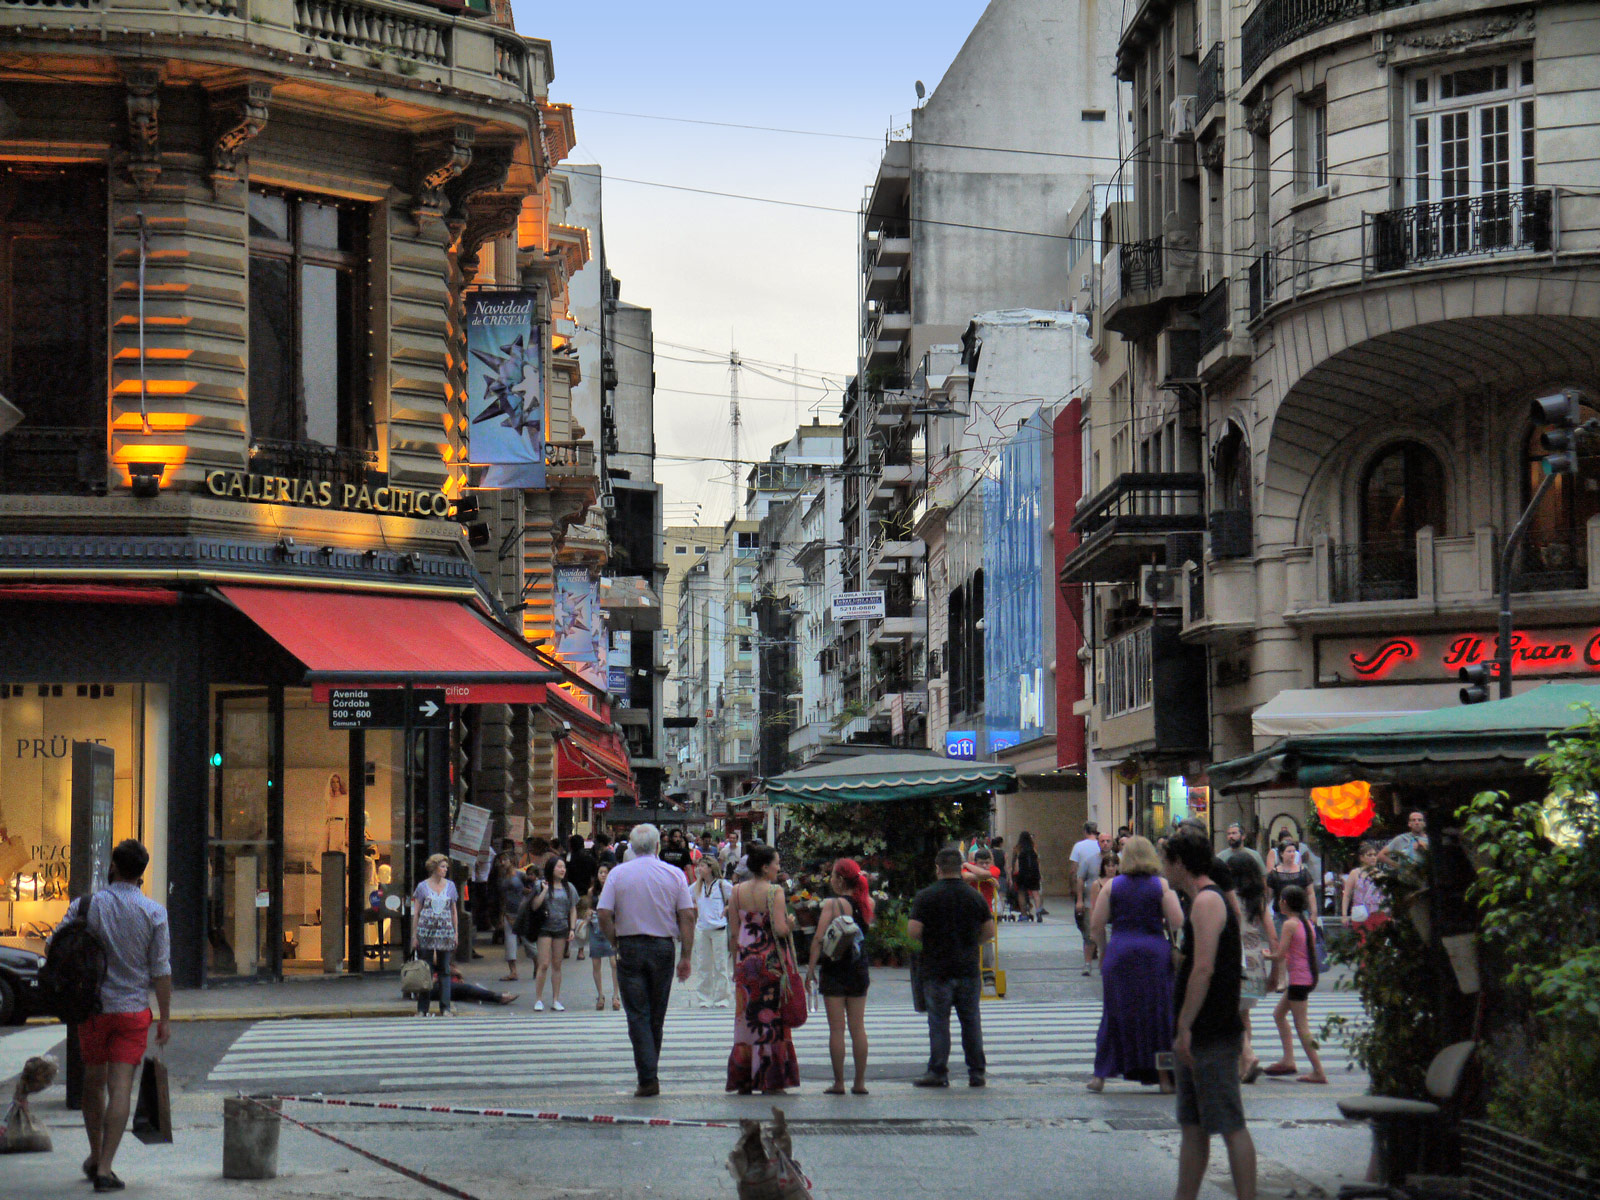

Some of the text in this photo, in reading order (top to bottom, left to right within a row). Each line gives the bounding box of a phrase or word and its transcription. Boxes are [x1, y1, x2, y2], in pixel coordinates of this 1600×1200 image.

[473, 300, 531, 315] Navidad
[472, 315, 529, 326] de CRISTAL
[207, 470, 450, 517] GALERIAS PACIFICO
[558, 568, 588, 577] Navidad
[1443, 637, 1482, 664] Il
[333, 690, 369, 698] Avenida
[332, 699, 370, 708] Córdoba
[332, 710, 349, 718] 500
[355, 710, 372, 718] 600
[947, 740, 974, 756] citi
